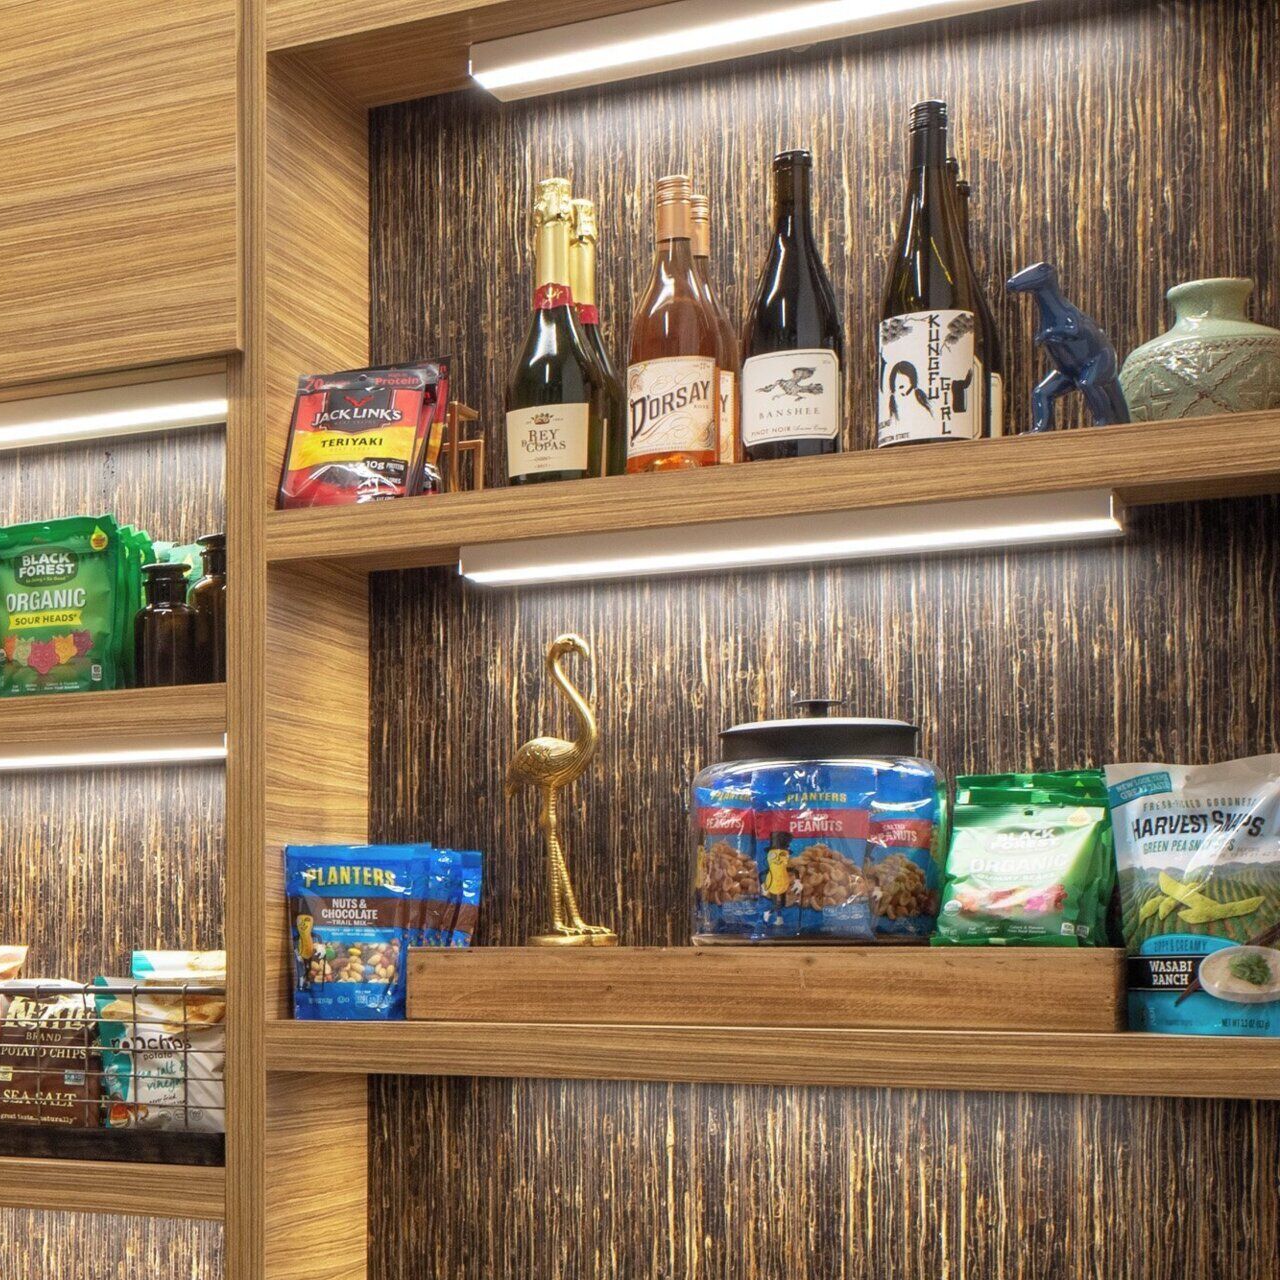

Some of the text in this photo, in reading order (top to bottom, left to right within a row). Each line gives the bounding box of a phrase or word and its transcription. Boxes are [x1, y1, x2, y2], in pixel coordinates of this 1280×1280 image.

[374, 377, 419, 386] Protein
[941, 377, 951, 435] GIRL
[312, 407, 402, 426] JACK LINK'S
[630, 382, 710, 447] D'ORSAY
[758, 407, 821, 419] BANSHEE
[529, 429, 560, 441] REY
[321, 437, 383, 448] TERIYAKI
[365, 460, 385, 470] 10g
[21, 552, 71, 566] BLACK
[19, 563, 74, 578] FOREST
[6, 588, 86, 614] ORGANIC
[14, 615, 41, 626] SOUR
[787, 792, 847, 803] PLANTERS
[790, 820, 842, 832] PEANUTS
[1133, 814, 1208, 841] HARVEST
[1143, 840, 1187, 854] GREEN PEA
[305, 866, 395, 888] PLANTERS
[332, 899, 366, 908] NUTS &
[322, 909, 378, 920] CHOCOLATE
[1149, 960, 1192, 973] WASABI
[1152, 973, 1189, 986] RANCH
[26, 1032, 61, 1041] BRAND
[49, 1049, 86, 1059] CHIPS
